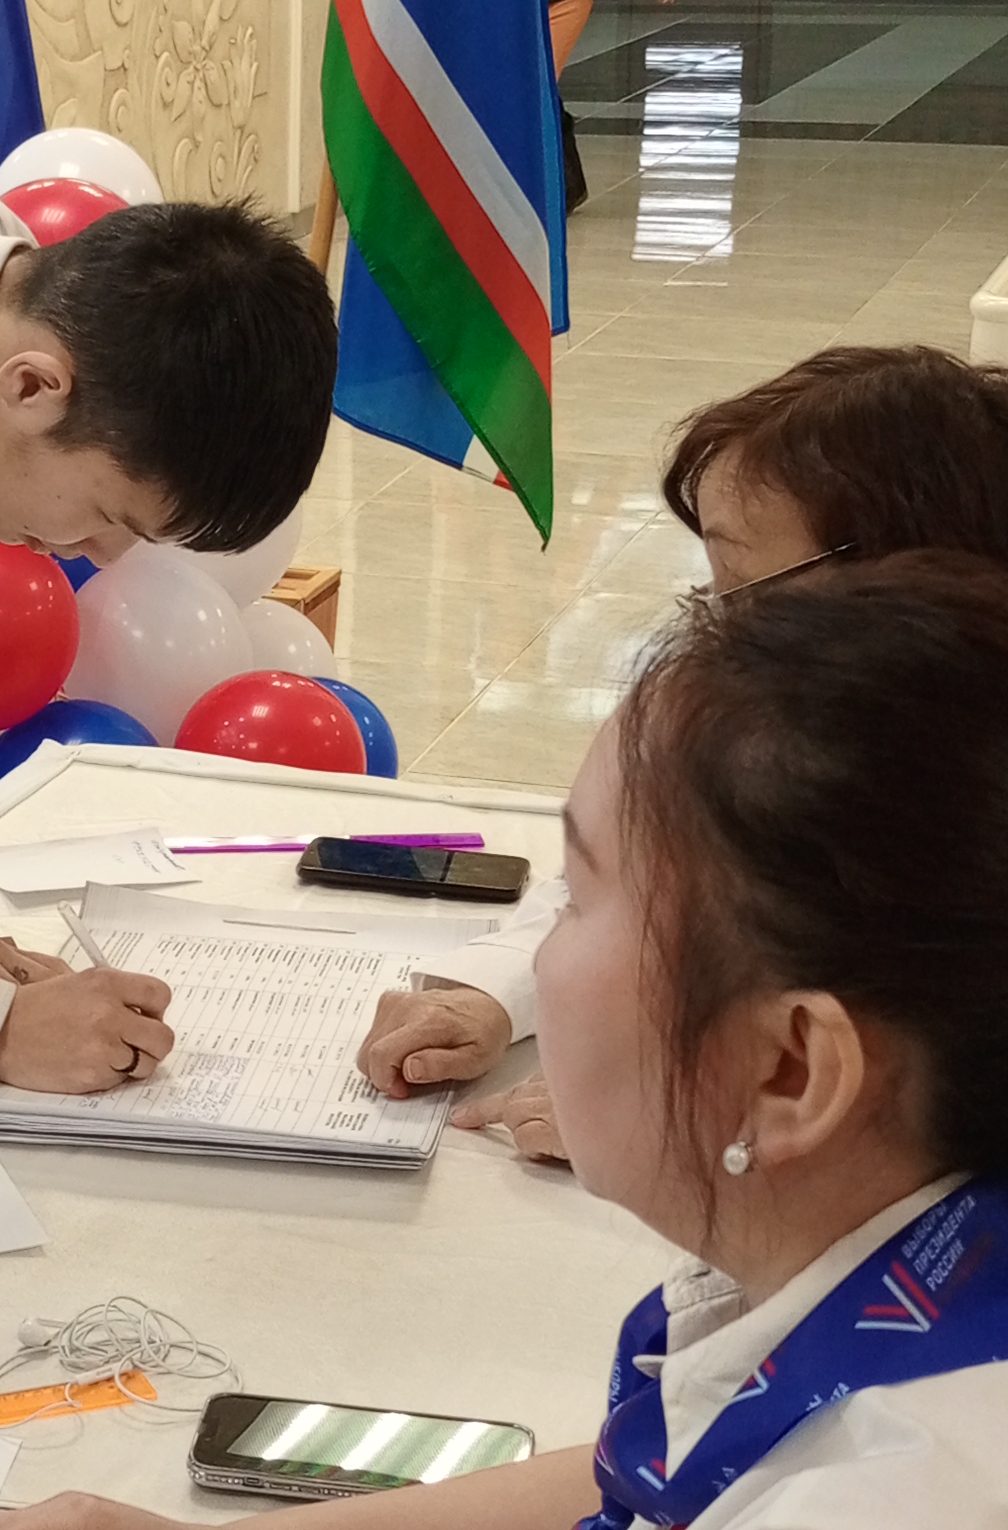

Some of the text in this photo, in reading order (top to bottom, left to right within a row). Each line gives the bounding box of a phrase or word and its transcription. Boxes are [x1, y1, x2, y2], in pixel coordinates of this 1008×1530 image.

[901, 1203, 947, 1259] ВЫБОРЫ
[913, 1195, 977, 1275] ПРЕЗИДЕНТА
[925, 1238, 964, 1291] РОССИИ
